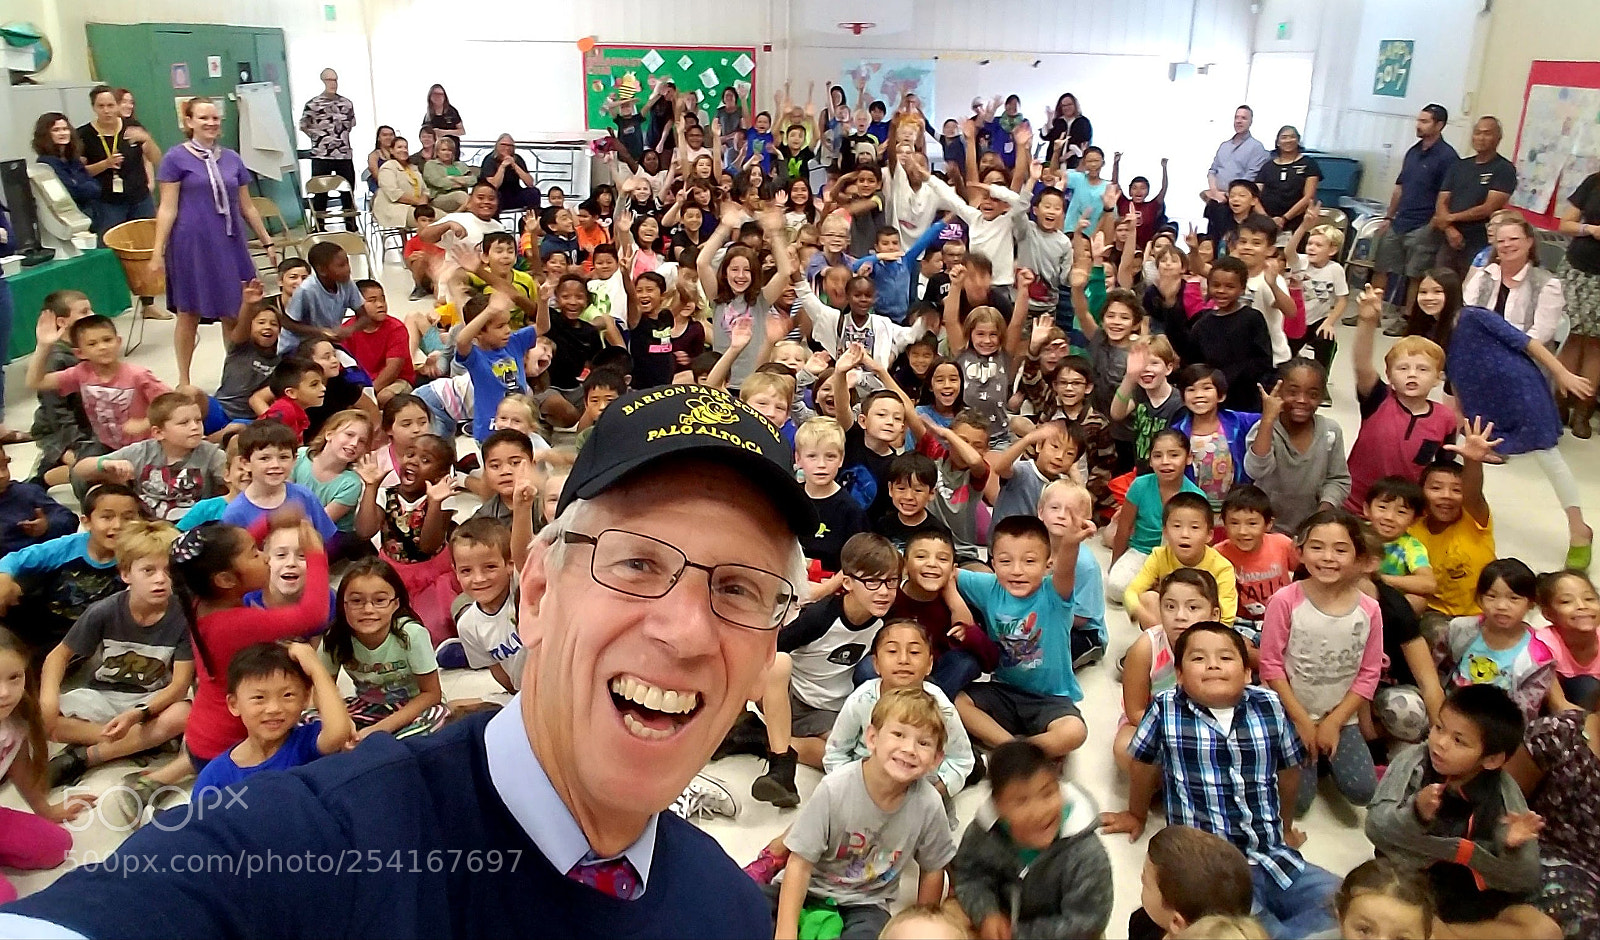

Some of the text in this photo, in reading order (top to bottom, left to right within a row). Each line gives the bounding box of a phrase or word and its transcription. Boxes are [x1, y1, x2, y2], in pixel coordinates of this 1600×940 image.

[622, 385, 781, 443] BARRON PARK SCHOOL
[646, 425, 694, 442] PALO
